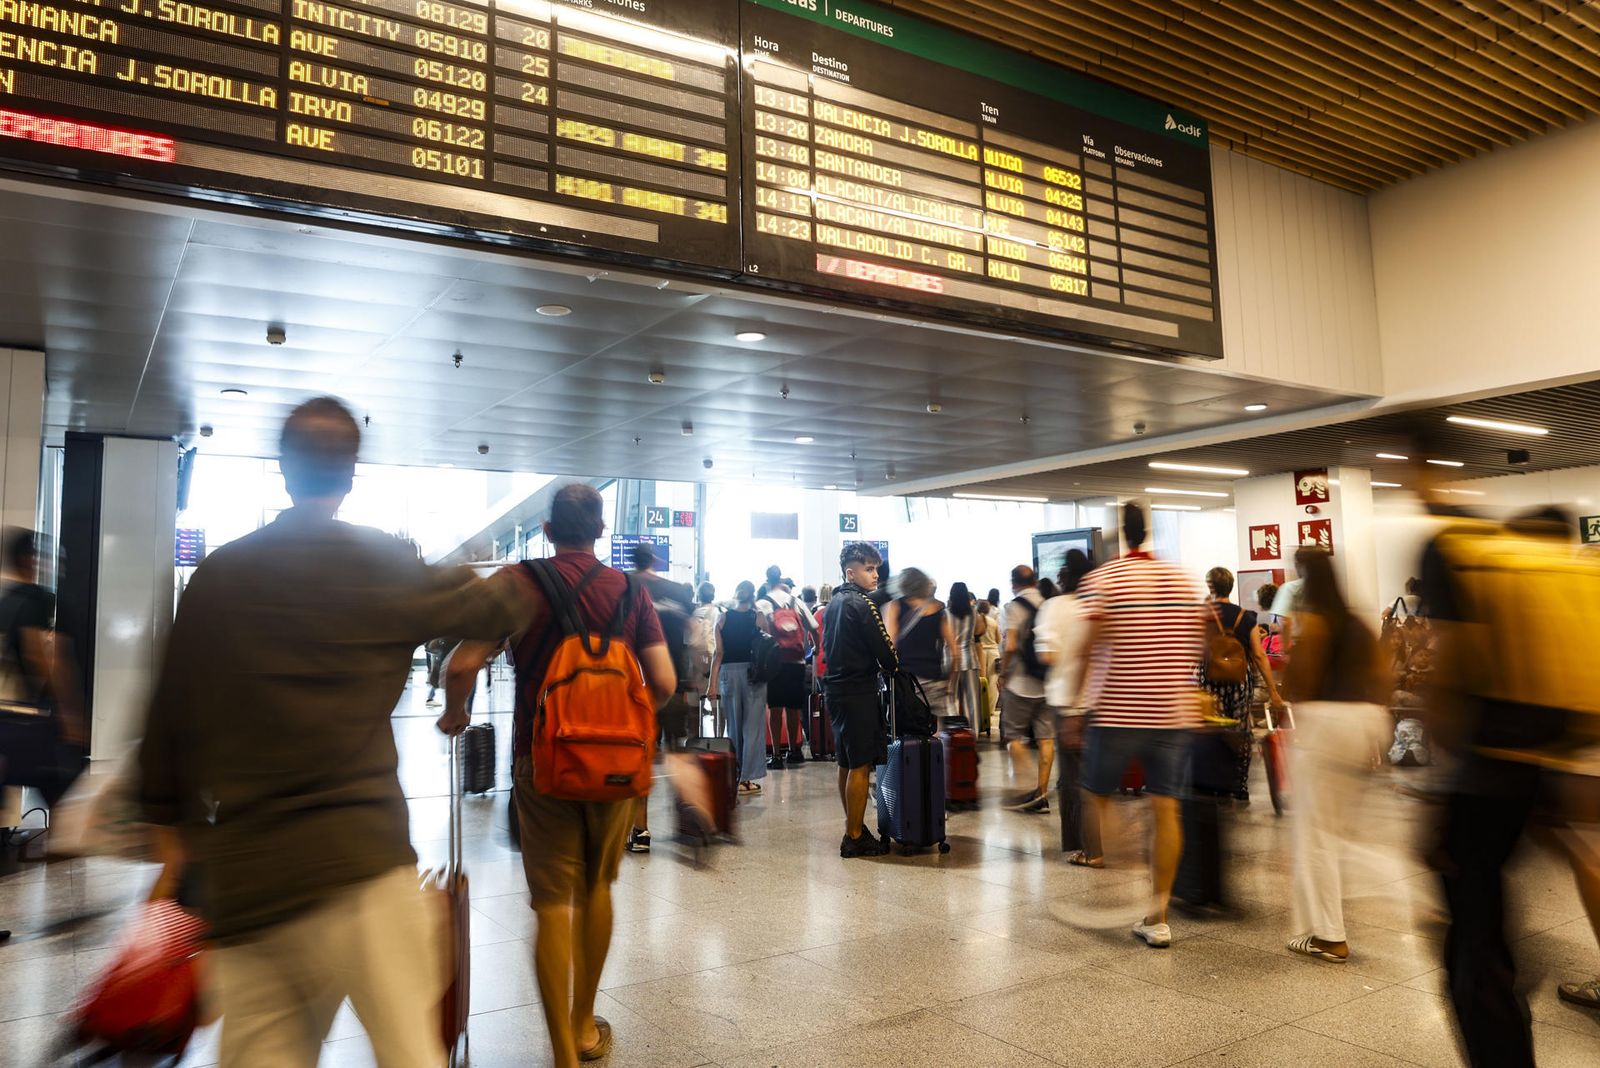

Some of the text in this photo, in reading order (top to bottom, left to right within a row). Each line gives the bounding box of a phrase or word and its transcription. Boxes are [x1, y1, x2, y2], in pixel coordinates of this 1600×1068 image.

[415, 0, 549, 50] 08129 20
[835, 8, 894, 38] DEPARTURES
[293, 0, 400, 41] INTCITY
[414, 29, 487, 63] 05910
[521, 54, 549, 77] 25
[754, 35, 779, 52] Hora
[753, 48, 770, 57] TIME
[812, 52, 848, 72] Destino
[290, 31, 338, 58] AVE
[414, 59, 486, 91] 05120
[521, 82, 548, 106] 24
[812, 65, 850, 82] DESTINATION
[116, 58, 278, 109] J.SOROLLA
[289, 92, 352, 123] IRYO
[412, 118, 485, 150] 06122
[289, 61, 368, 95] ALVIA
[413, 88, 486, 122] 04929
[980, 102, 999, 116] Tren
[981, 113, 997, 124] TRAIN
[755, 86, 808, 116] 13:15
[813, 100, 892, 137] VALENCIA
[900, 126, 978, 162] J.SOROLLA
[1043, 166, 1082, 191] 06532
[1082, 134, 1094, 146] Vía
[1177, 121, 1202, 138] adif
[287, 124, 335, 152] AVE
[411, 147, 485, 180] 05101
[755, 111, 1083, 211] 13:20 ZAMORA ALVIA 04325
[1114, 145, 1163, 167] Observaciones
[755, 136, 809, 164] 13:40
[815, 149, 902, 187] SANTANDER
[985, 193, 1025, 217] ALVIA
[1046, 209, 1084, 233] 04143
[756, 161, 809, 190] 14:00
[816, 174, 964, 226] ALACANT/ALICANTE
[1048, 230, 1086, 254] 05142
[757, 187, 810, 215] 14:15
[816, 201, 965, 248] ALACANT/ALICANTE
[1049, 252, 1087, 275] 06944
[757, 213, 1088, 297] 14:23 VALLADOLID C. GR. AVLO 05817
[749, 265, 759, 273] L2
[648, 510, 664, 524] 24
[843, 516, 856, 530] 25
[658, 536, 668, 544] 24
